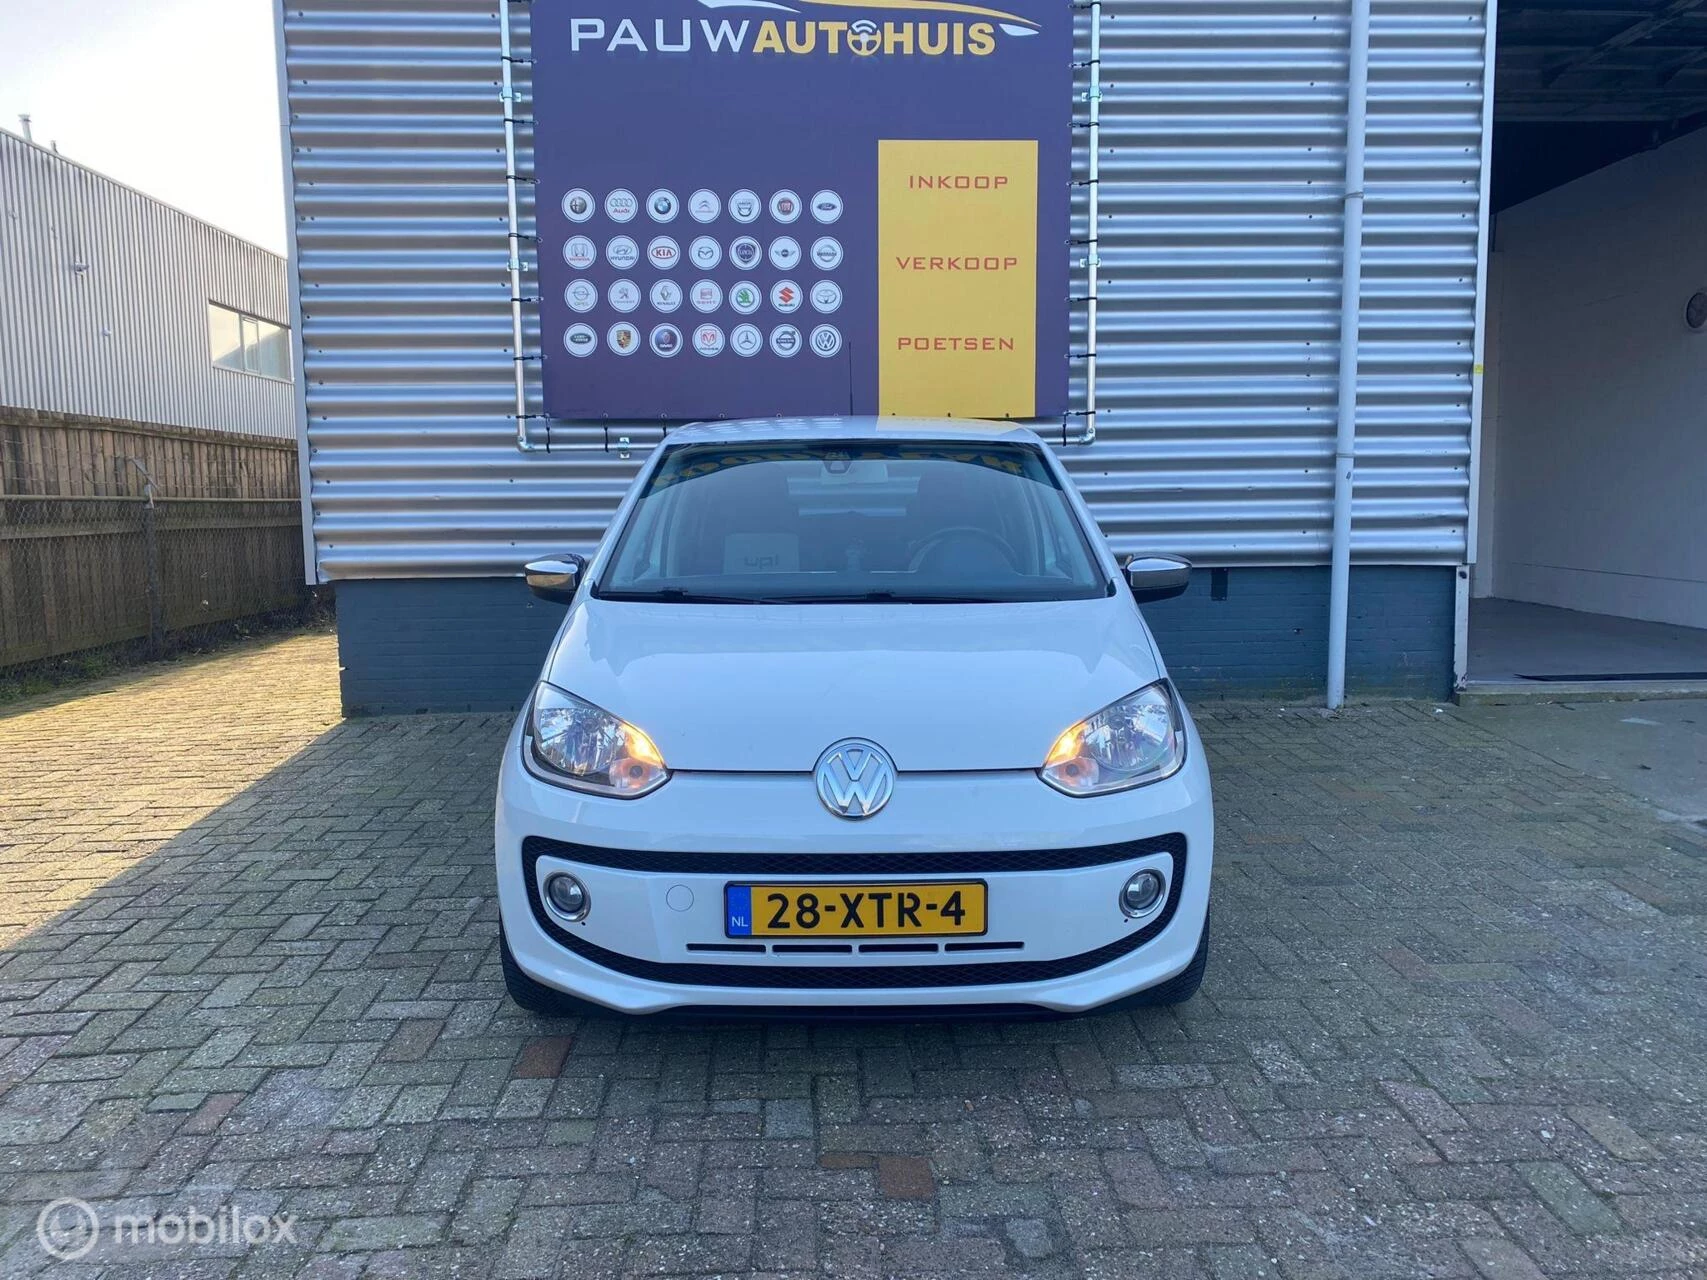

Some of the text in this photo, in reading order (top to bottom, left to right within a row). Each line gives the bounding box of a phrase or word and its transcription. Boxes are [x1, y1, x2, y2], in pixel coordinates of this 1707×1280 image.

[909, 175, 1009, 189] INKOOP
[655, 248, 673, 257] KIA
[896, 256, 1018, 271] VERKOOP
[898, 337, 1014, 351] POETSEN
[766, 890, 967, 930] 28-XTR-4
[731, 915, 749, 928] NL
